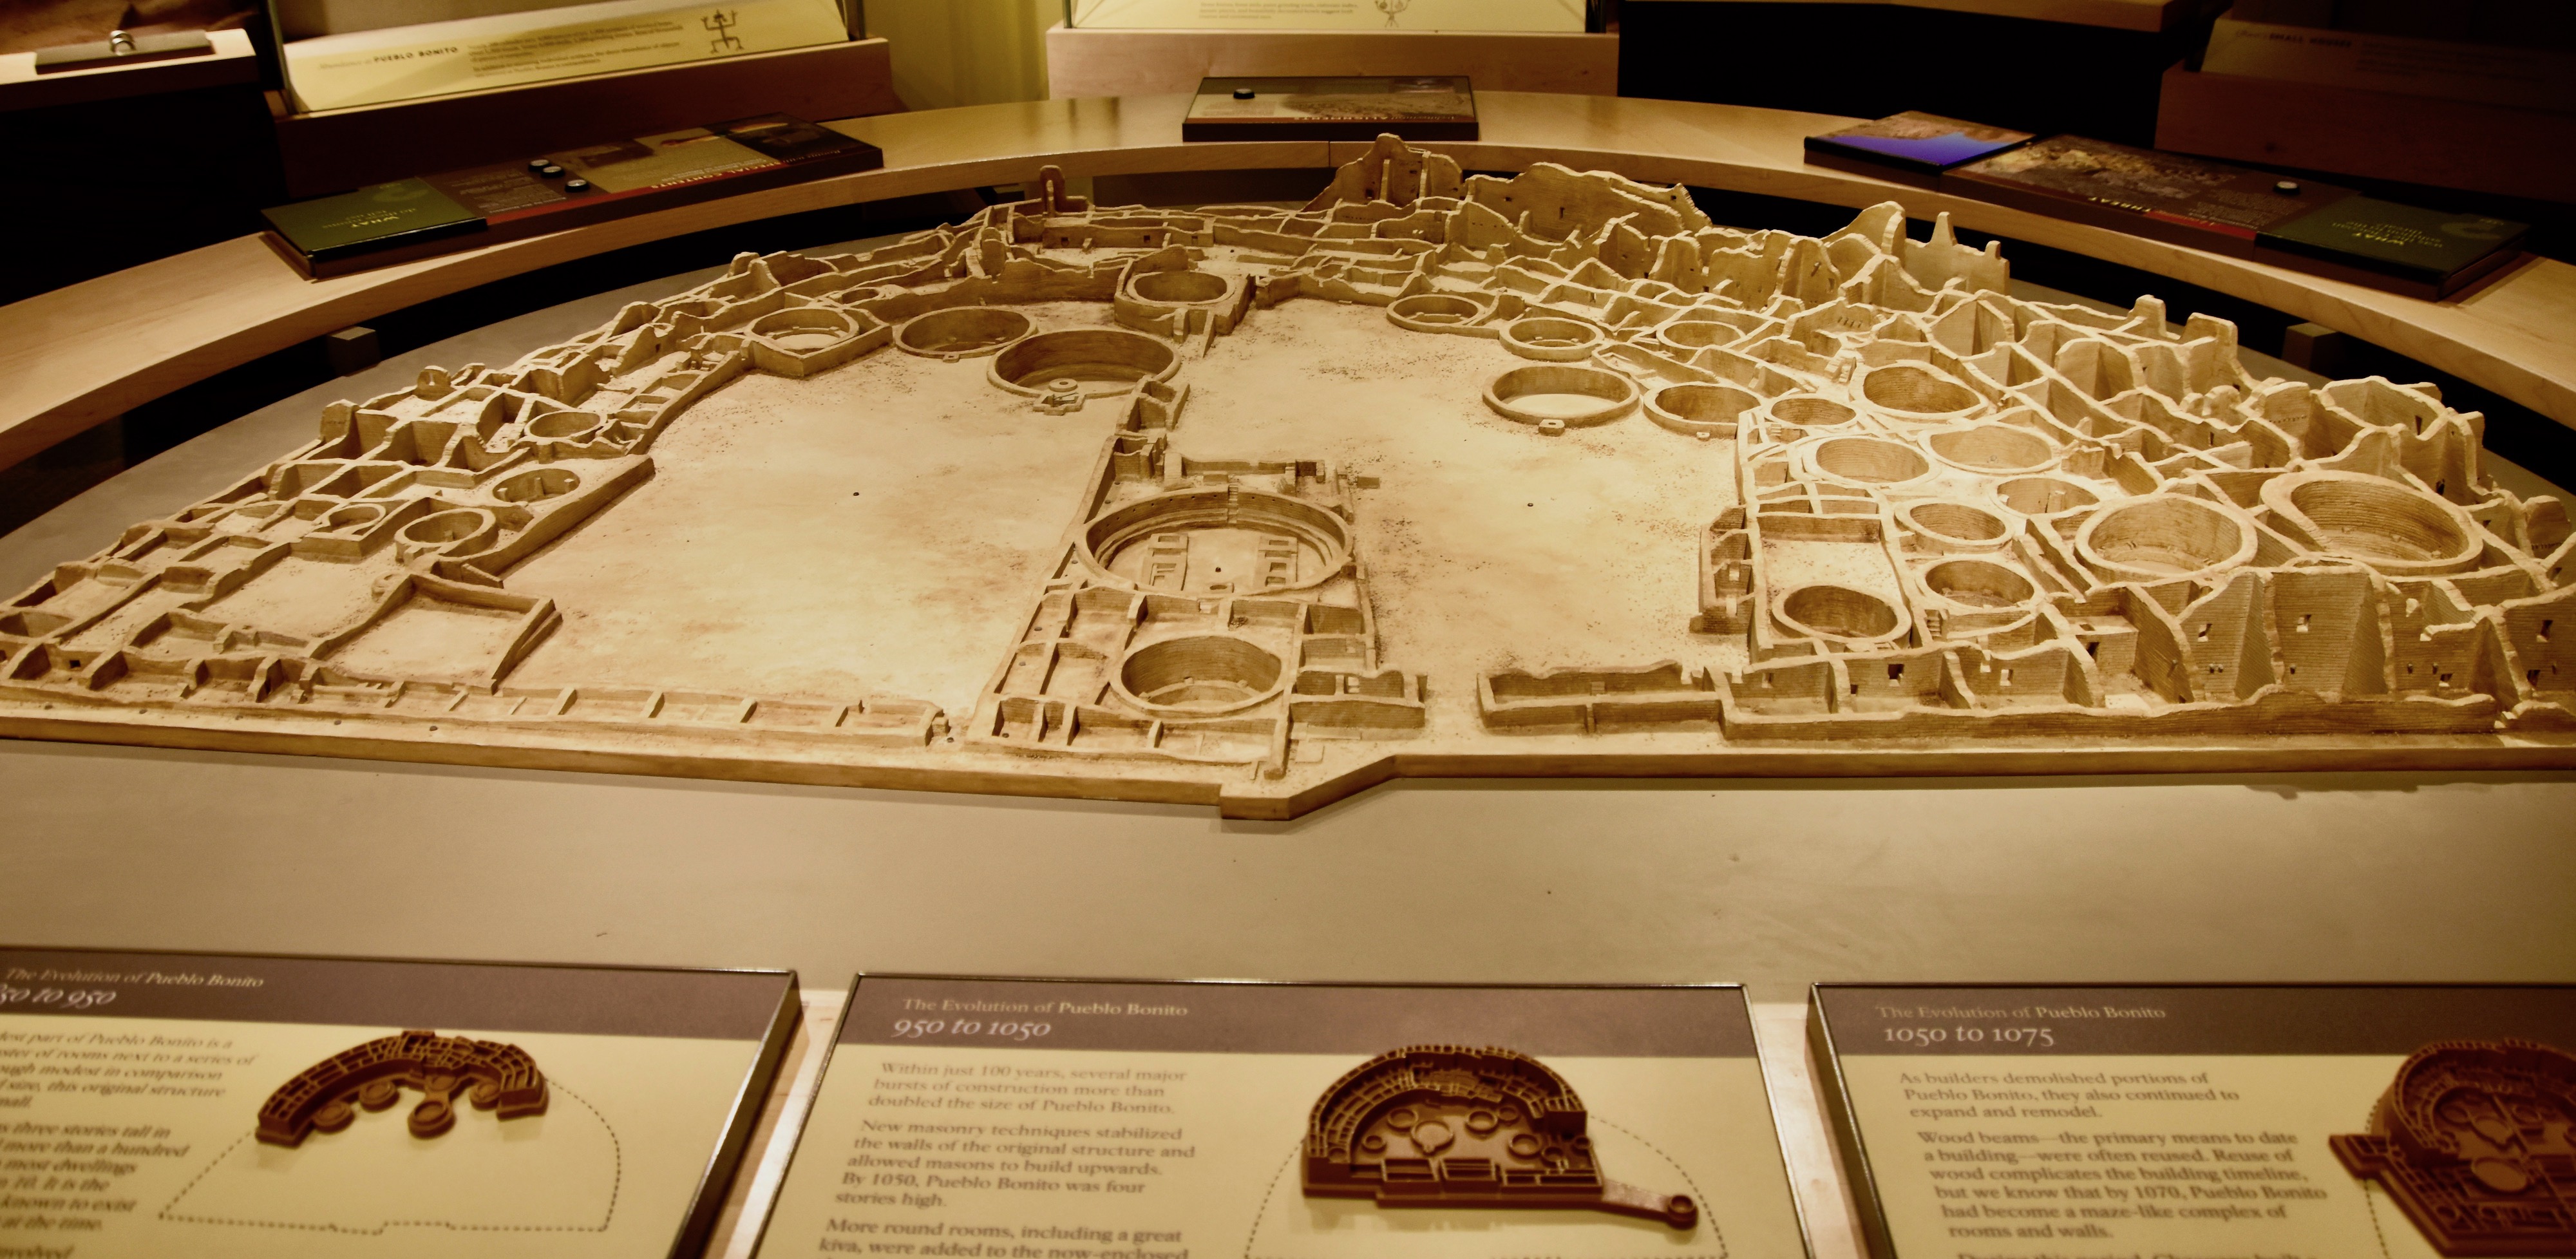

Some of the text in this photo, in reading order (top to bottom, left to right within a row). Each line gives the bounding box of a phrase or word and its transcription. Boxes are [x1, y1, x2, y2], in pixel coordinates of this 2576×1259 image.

[374, 46, 459, 63] PUEBLO BONITO
[726, 161, 781, 174] SPECIAL
[651, 172, 722, 189] CONTENTS
[2088, 196, 2151, 213] THREAT
[351, 216, 399, 228] WHAT
[2351, 232, 2404, 246] WHAT
[8, 968, 264, 987] The Evolution of Pueblo Bonito
[32, 987, 64, 1003] to
[59, 990, 117, 1009] 950
[904, 999, 1188, 1016] The Evolution of Pueblo Bonito
[1879, 1006, 2167, 1018] The Evolution of Pueblo Bonito
[891, 1019, 1052, 1041] 950 to 1050
[1885, 1026, 2055, 1046] 1050 to 1075
[89, 1034, 144, 1045] Pueblo
[149, 1036, 204, 1046] Bonito
[57, 1051, 232, 1063] rooms next series
[39, 1065, 223, 1081] modest comparison
[882, 1062, 1186, 1084] Within just 100 years, several major
[1900, 1072, 2209, 1087] As builders demolished portions of
[47, 1079, 77, 1092] this
[82, 1082, 149, 1097] original
[151, 1085, 227, 1097] structure
[875, 1079, 1166, 1097] bursts of construction more than
[1903, 1088, 2240, 1104] Pueblo Bonito, they also continued to
[867, 1095, 1177, 1113] doubled the size of Pueblo Bonito.
[1909, 1105, 2103, 1121] expand and remodel.
[862, 1119, 1183, 1139] New masonry techniques stabilized
[854, 1137, 1196, 1159] the walls of the original structure and
[1917, 1131, 1975, 1143] Wood
[2092, 1132, 2166, 1148] primary
[2172, 1133, 2230, 1144] means
[2235, 1133, 2254, 1144] to
[2259, 1131, 2298, 1144] date
[1924, 1153, 1935, 1162] a
[2087, 1149, 2137, 1162] often
[2141, 1150, 2208, 1162] reused.
[2211, 1150, 2269, 1162] Reuse
[2273, 1148, 2295, 1162] of
[848, 1155, 1165, 1177] allowed masons to build upwards.
[842, 1171, 1147, 1193] By 1050, Pueblo Bonito was four
[1929, 1167, 2311, 1184] wood complicates the building timeline,
[835, 1192, 946, 1209] stories high.
[1933, 1185, 2329, 1203] but we know that by 1070, Pueblo Bonito
[1940, 1204, 2287, 1222] had become a maze-like complex of
[826, 1218, 1182, 1246] More round rooms, including a great
[1947, 1224, 2117, 1238] rooms and walls.
[819, 1238, 1189, 1259] kiva, were added to the now-enclosed
